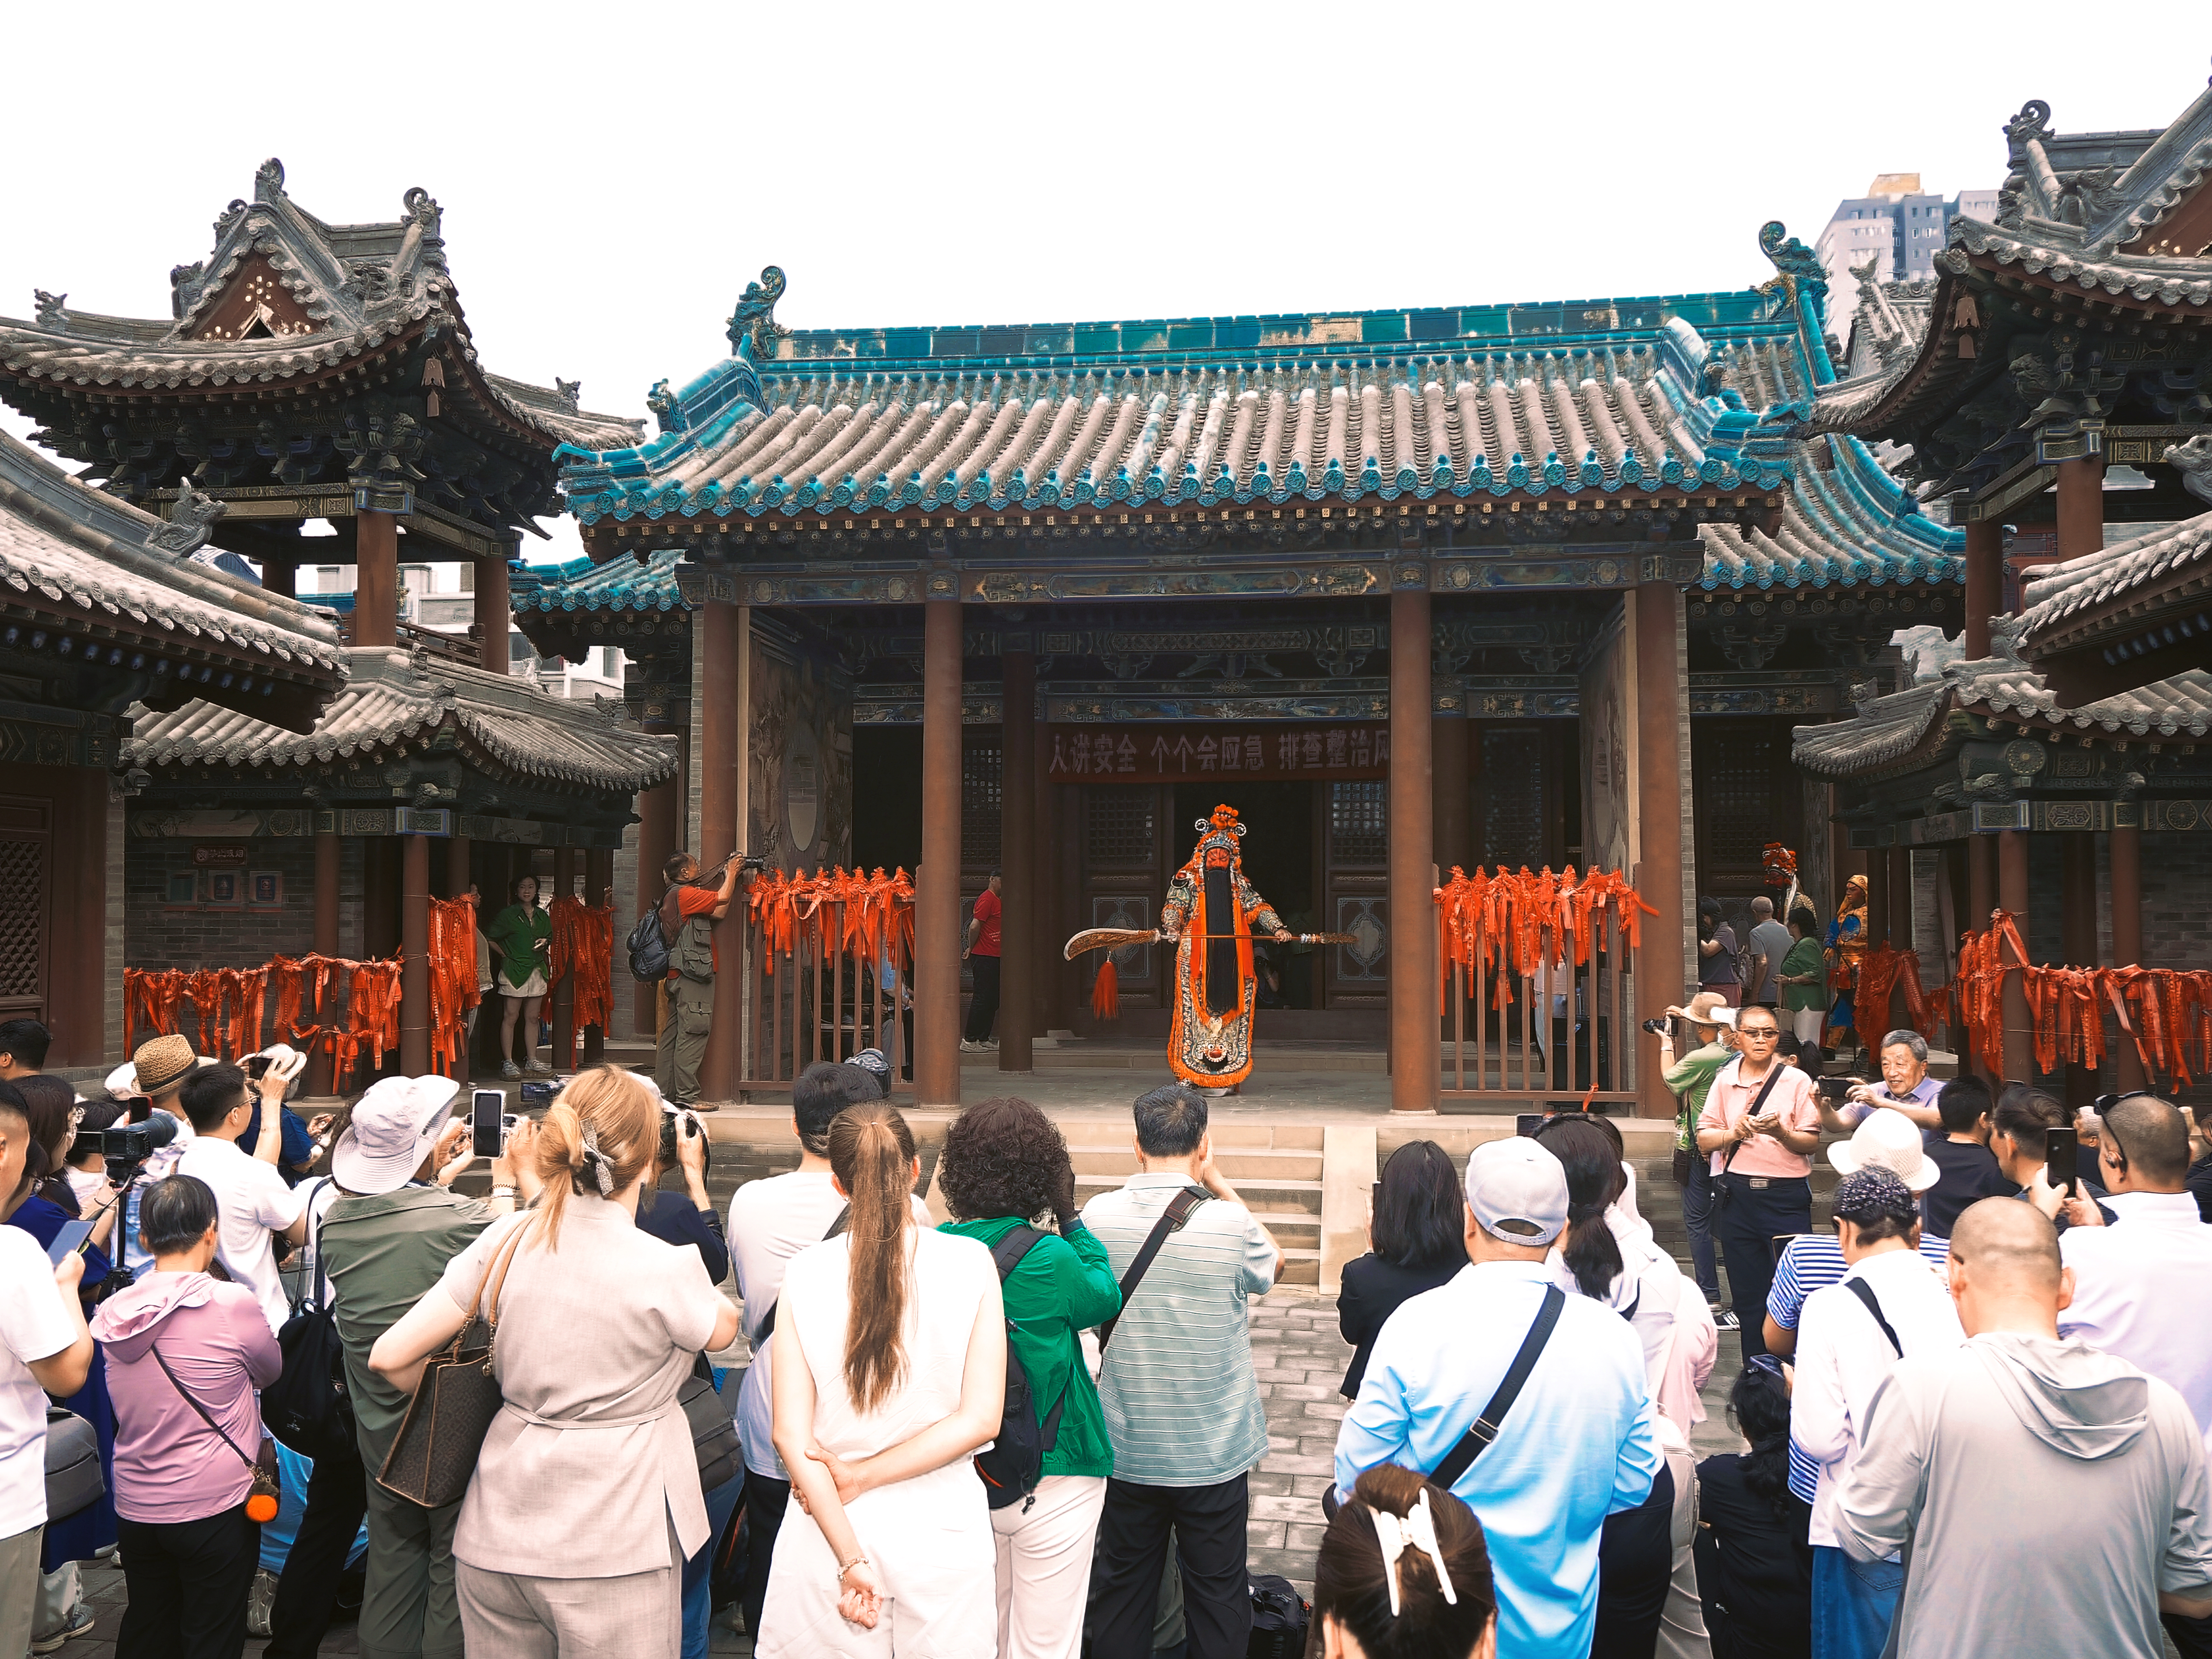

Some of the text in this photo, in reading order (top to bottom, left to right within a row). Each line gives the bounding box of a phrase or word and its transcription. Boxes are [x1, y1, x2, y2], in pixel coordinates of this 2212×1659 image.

[1048, 733, 1137, 774] 人讲安全
[1150, 733, 1265, 774] 个个会应急
[209, 849, 243, 857] 禁止吸烟
